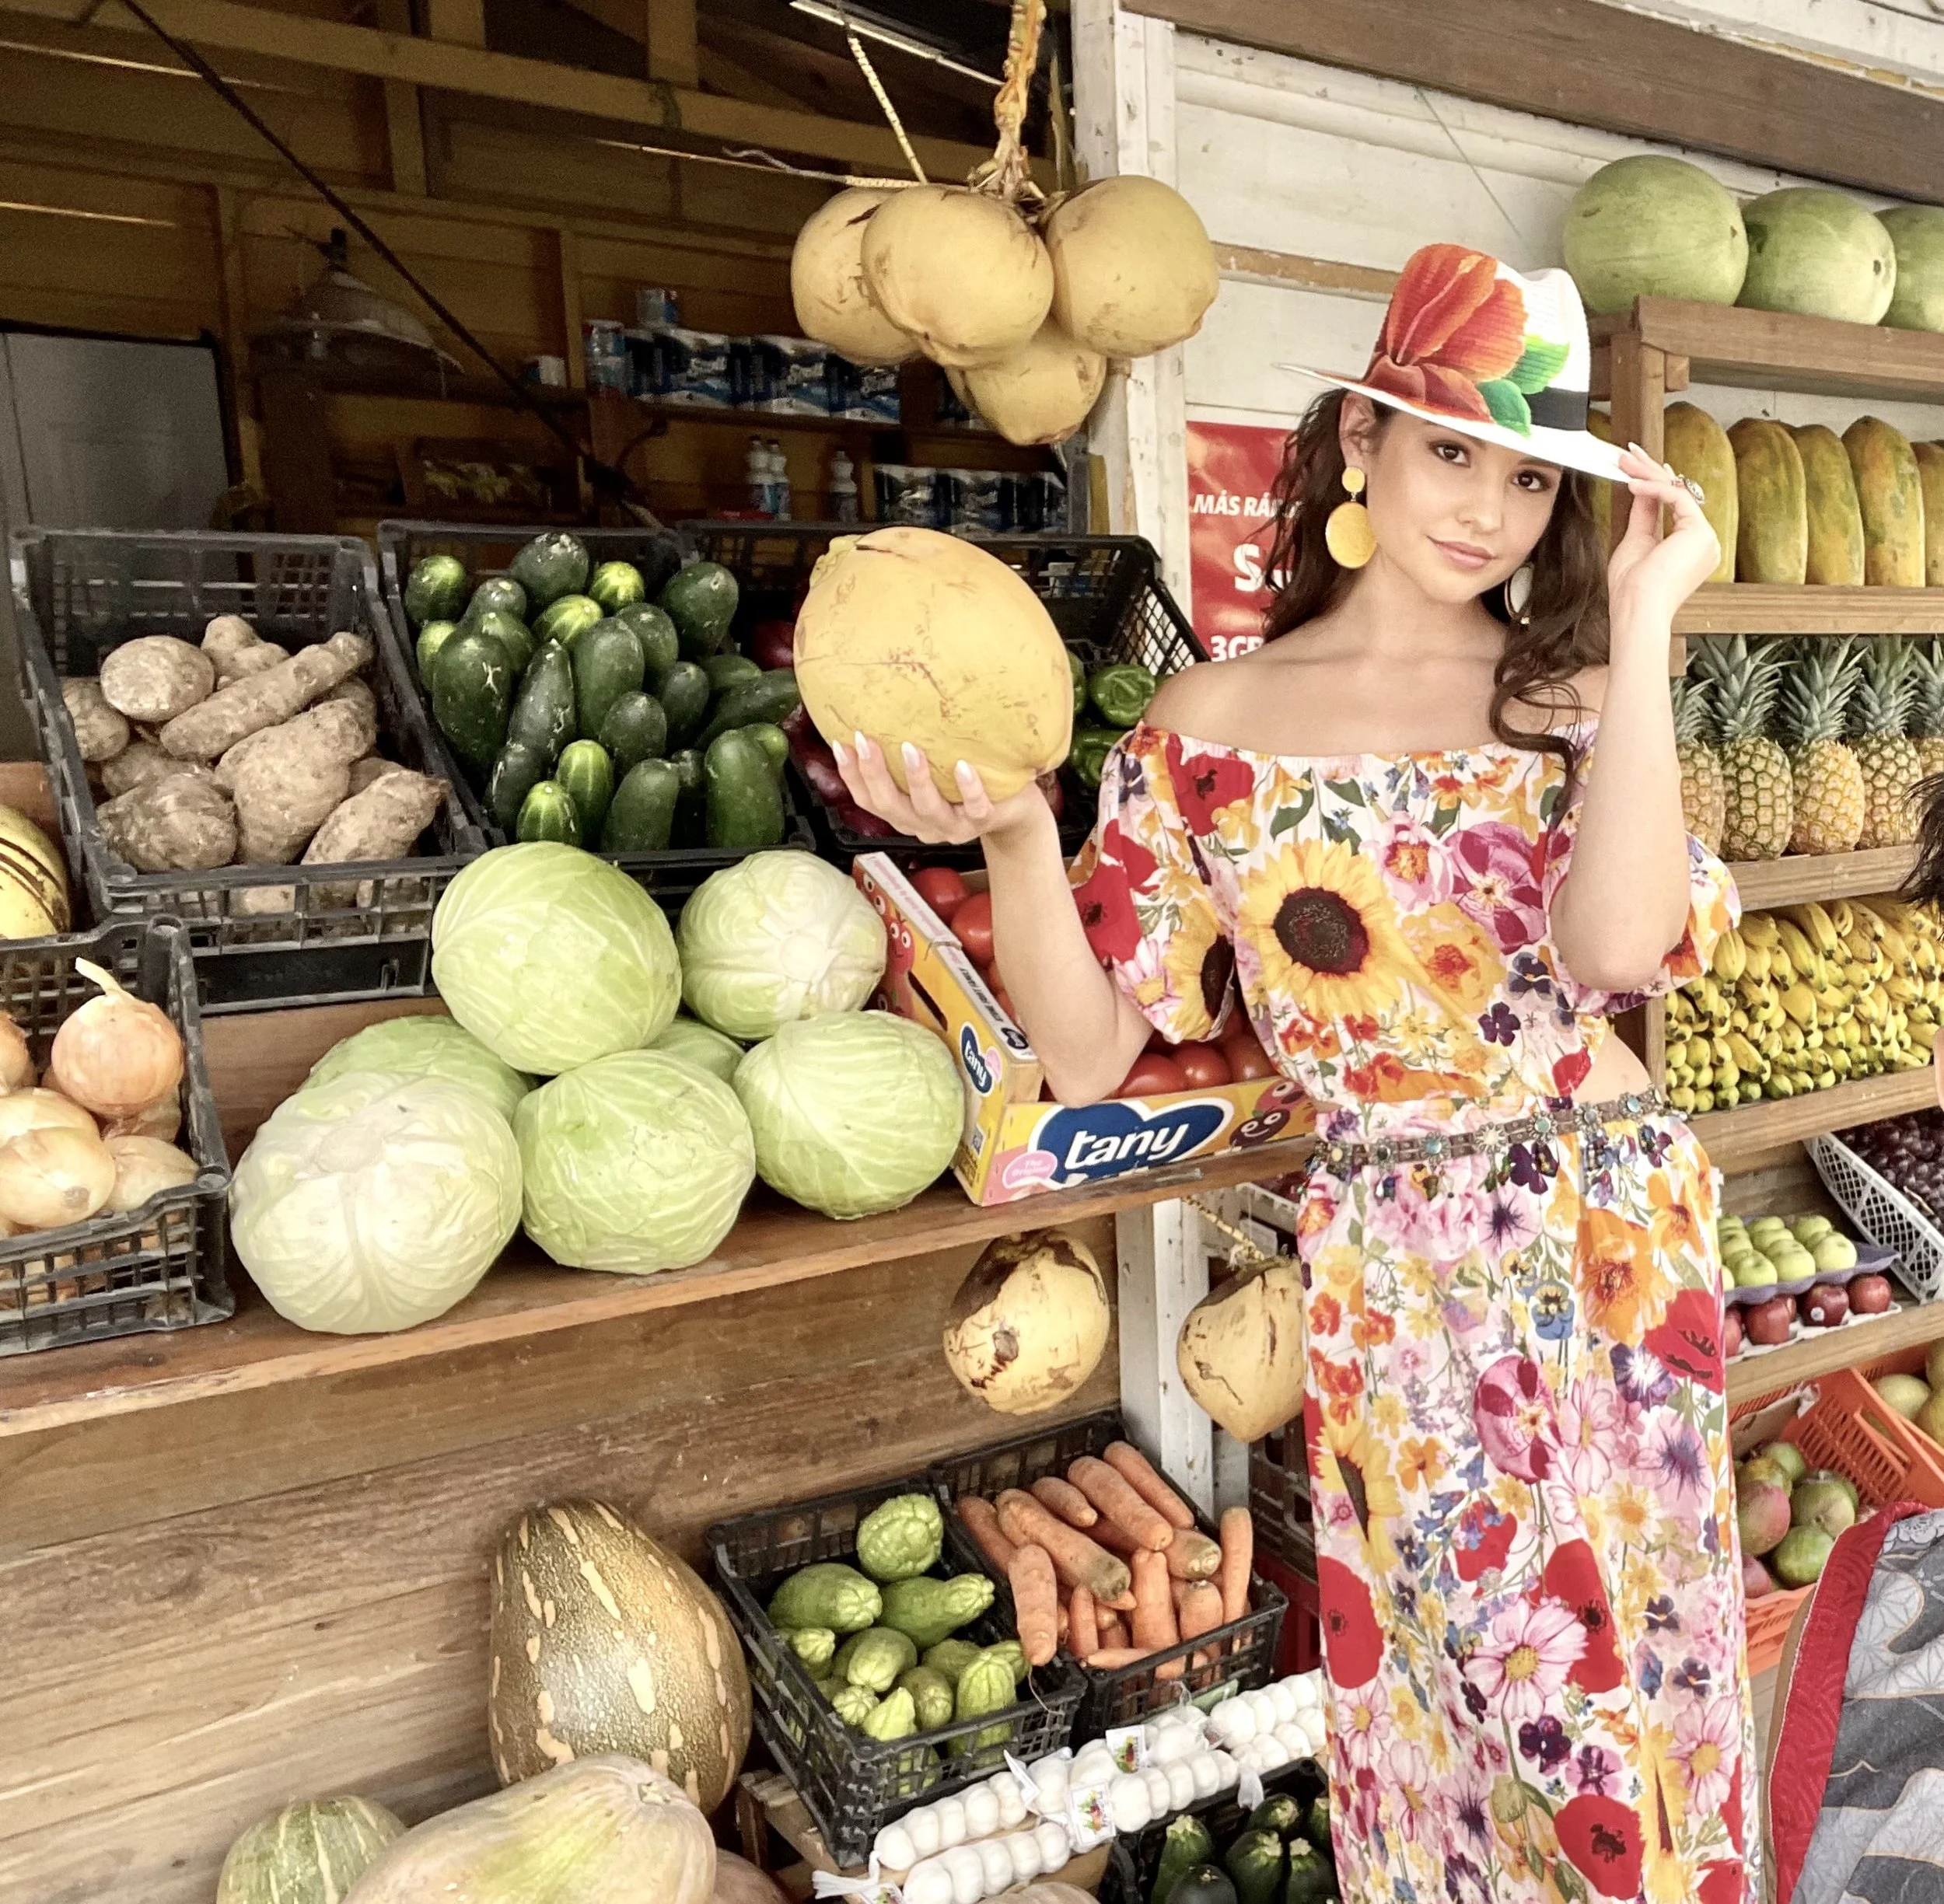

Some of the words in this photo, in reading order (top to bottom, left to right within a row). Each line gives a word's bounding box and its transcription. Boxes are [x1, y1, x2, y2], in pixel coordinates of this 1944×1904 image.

[1193, 489, 1241, 516] MÁS
[964, 1039, 988, 1087] tany
[1064, 1123, 1189, 1170] tany
